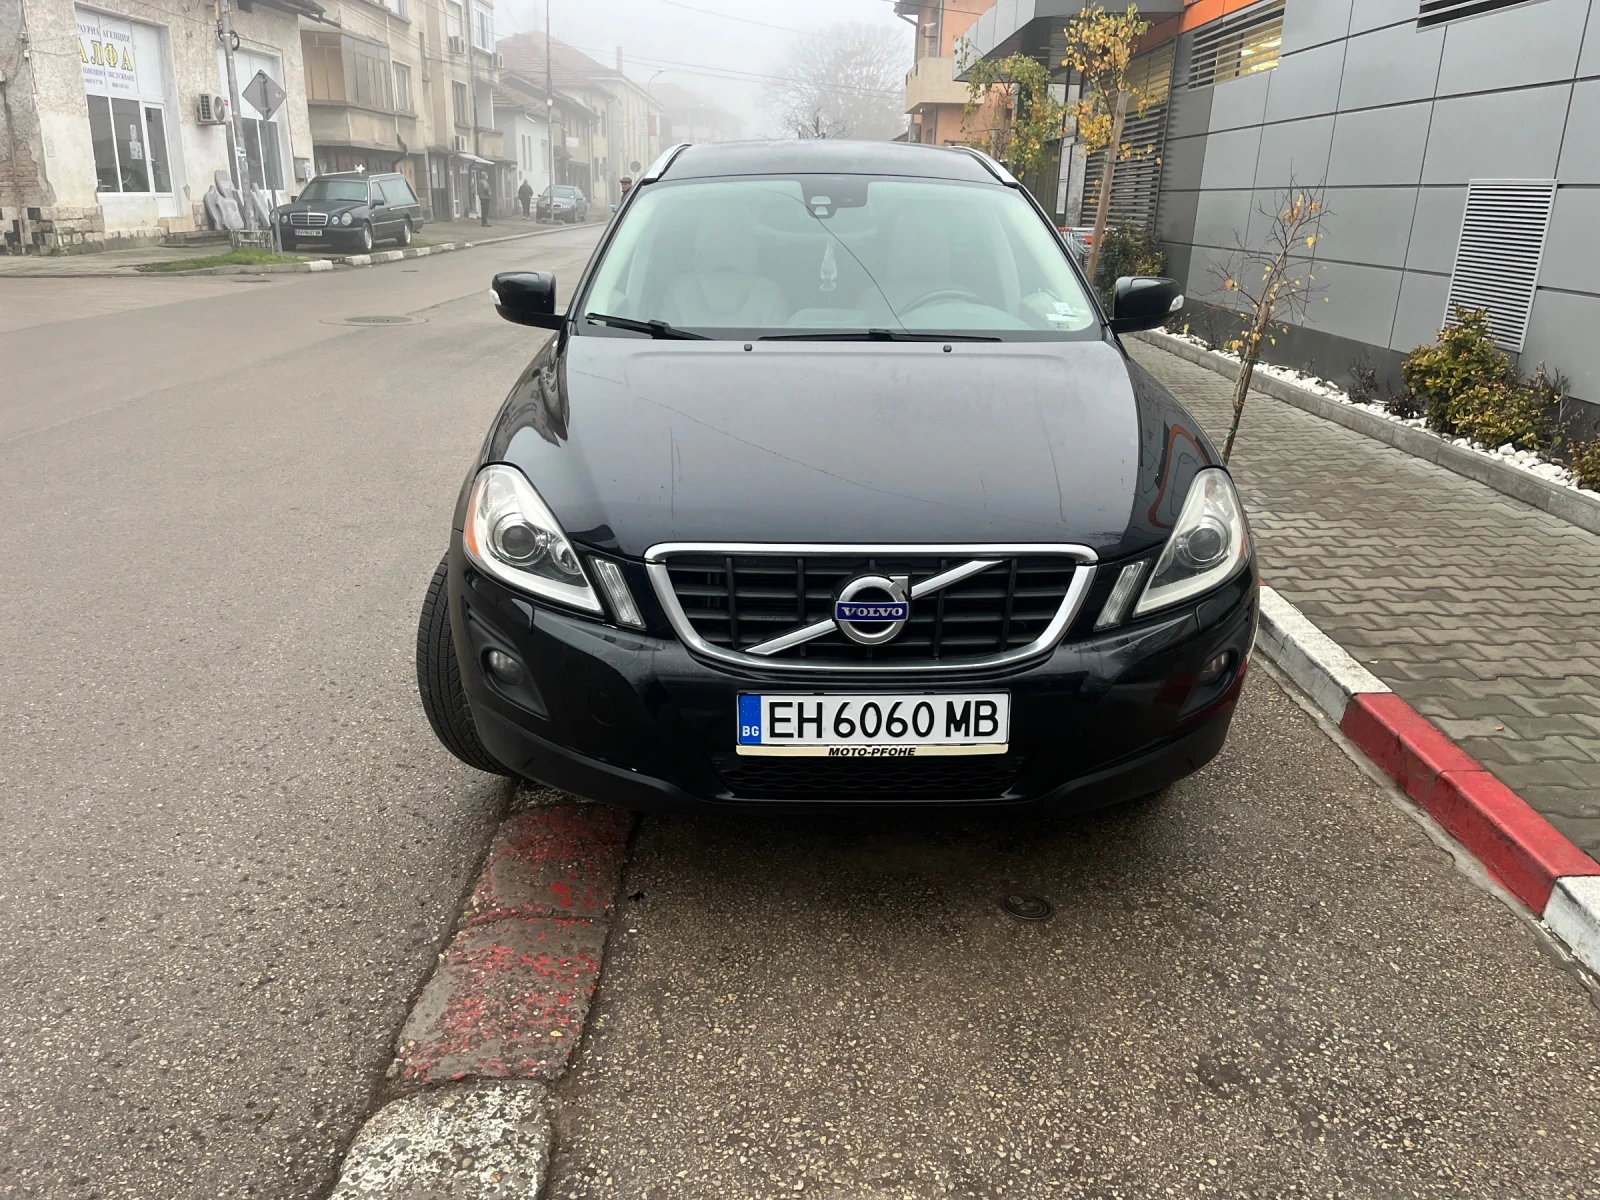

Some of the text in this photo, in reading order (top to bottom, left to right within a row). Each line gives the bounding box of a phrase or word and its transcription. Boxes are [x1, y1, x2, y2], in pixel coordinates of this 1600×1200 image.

[102, 30, 130, 43] АГЕНЦИЯ
[78, 36, 133, 71] АЛФА
[841, 607, 903, 616] VOLVO
[768, 700, 999, 738] EH 6060 MB
[741, 726, 760, 737] BG
[827, 747, 916, 757] MOTO-PFOHE
